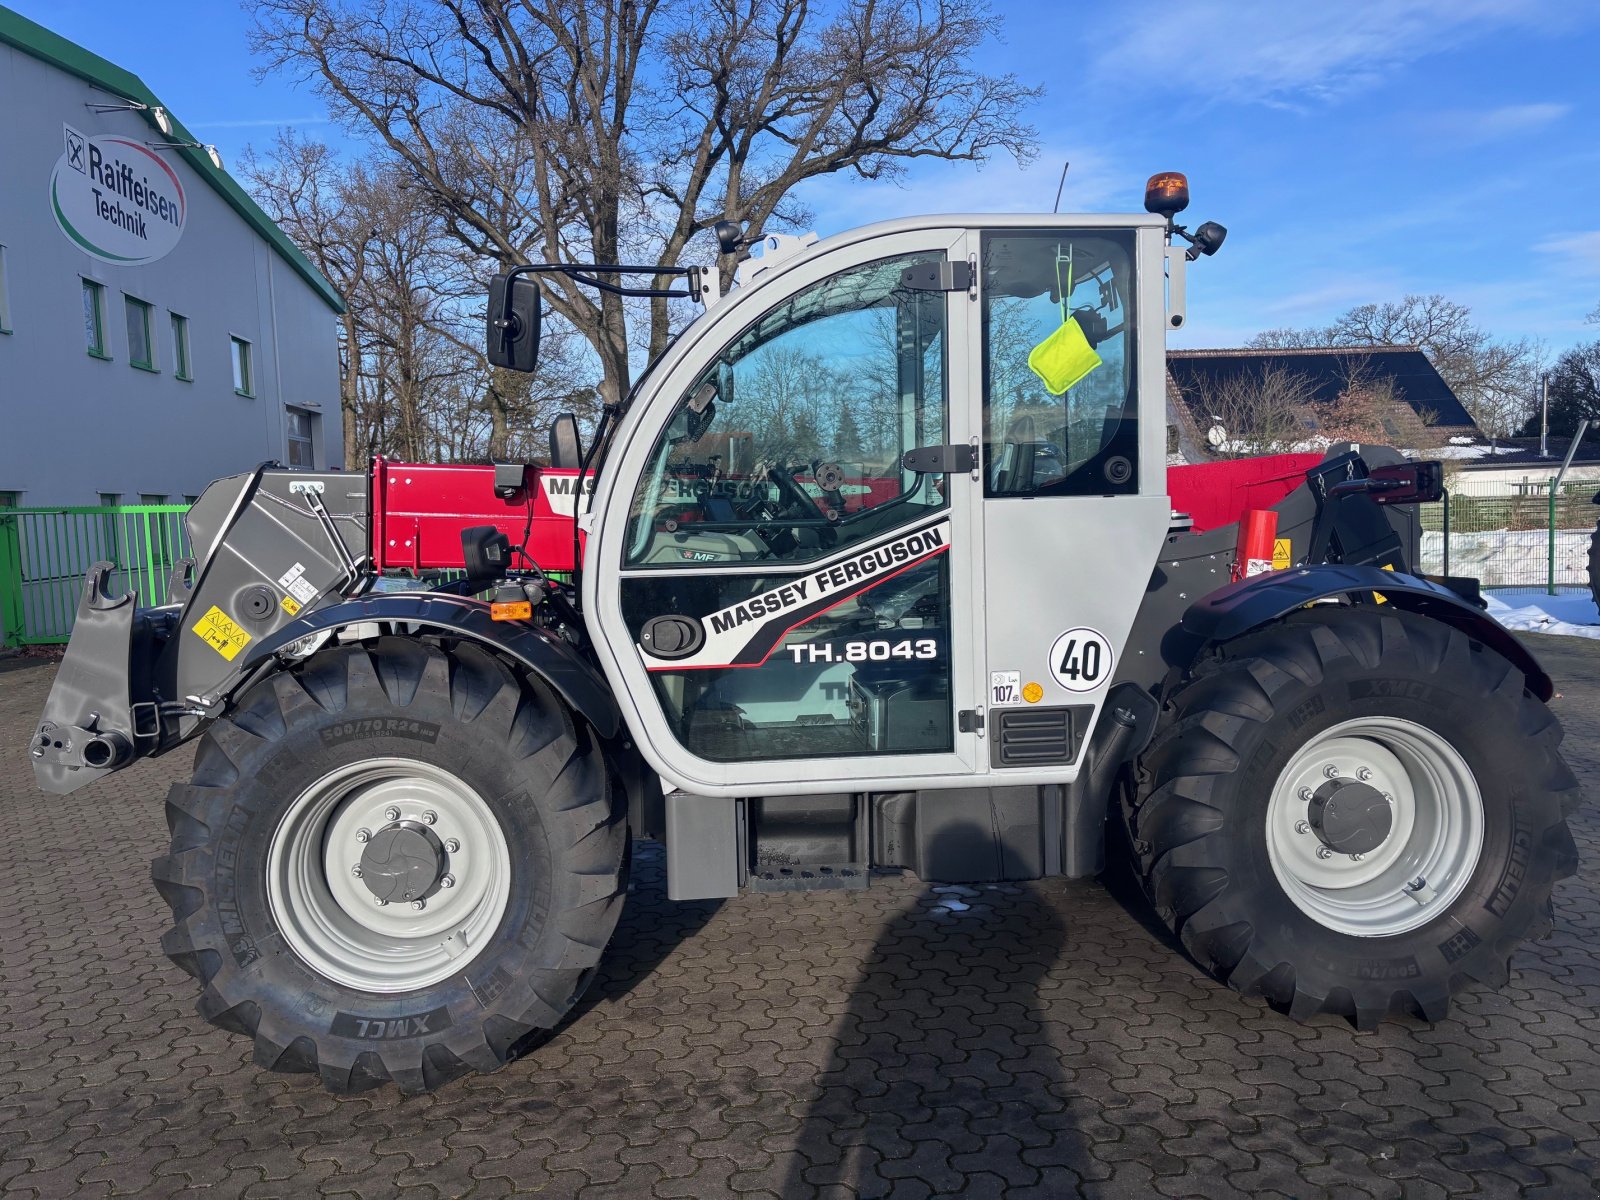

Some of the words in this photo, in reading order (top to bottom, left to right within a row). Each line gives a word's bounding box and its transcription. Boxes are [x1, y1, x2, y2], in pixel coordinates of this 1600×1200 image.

[88, 142, 179, 227] Raiffeisen
[91, 187, 148, 240] Technik
[709, 580, 807, 634] MASSEY
[815, 528, 944, 593] FERGUSON
[786, 639, 938, 664] TH.8043
[1059, 639, 1101, 682] 40
[993, 685, 1013, 702] 107
[322, 719, 383, 741] 500/70
[216, 804, 252, 935] MICHELIN
[1489, 800, 1533, 917] MICHELIN
[355, 1014, 431, 1040] XMCL
